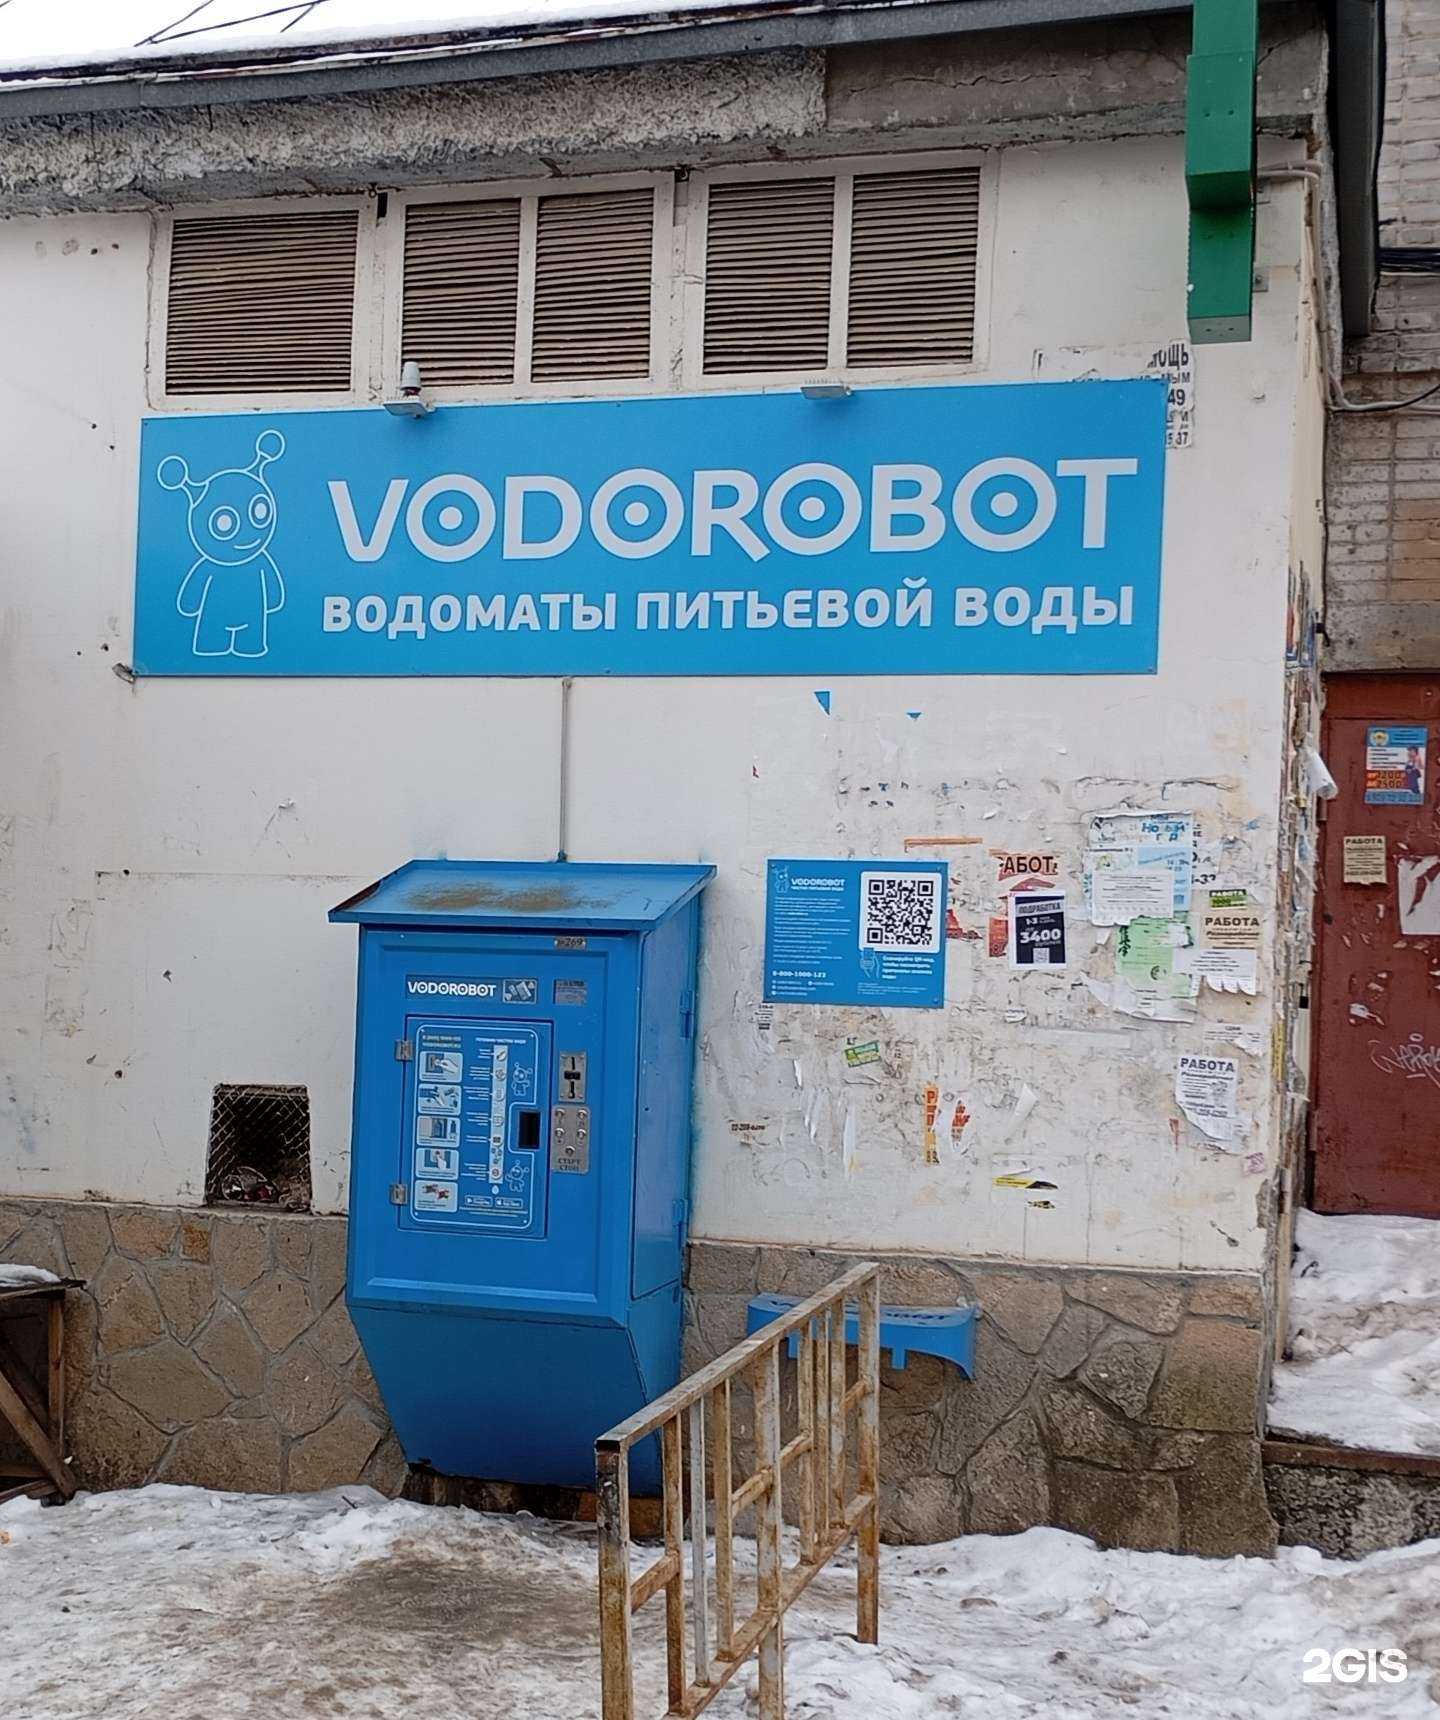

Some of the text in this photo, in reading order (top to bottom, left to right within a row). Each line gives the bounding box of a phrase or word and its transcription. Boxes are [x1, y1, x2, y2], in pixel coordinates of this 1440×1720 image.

[328, 457, 1138, 563] VODOROBOT
[323, 577, 1133, 639] ВОДОМАТЫ ПИТЬЕВОЙ ВОДЫ
[1205, 917, 1260, 926] РАБОТА
[1020, 929, 1061, 944] 3400
[407, 981, 496, 997] VODOROBOT
[1180, 1057, 1235, 1072] РАБОТА
